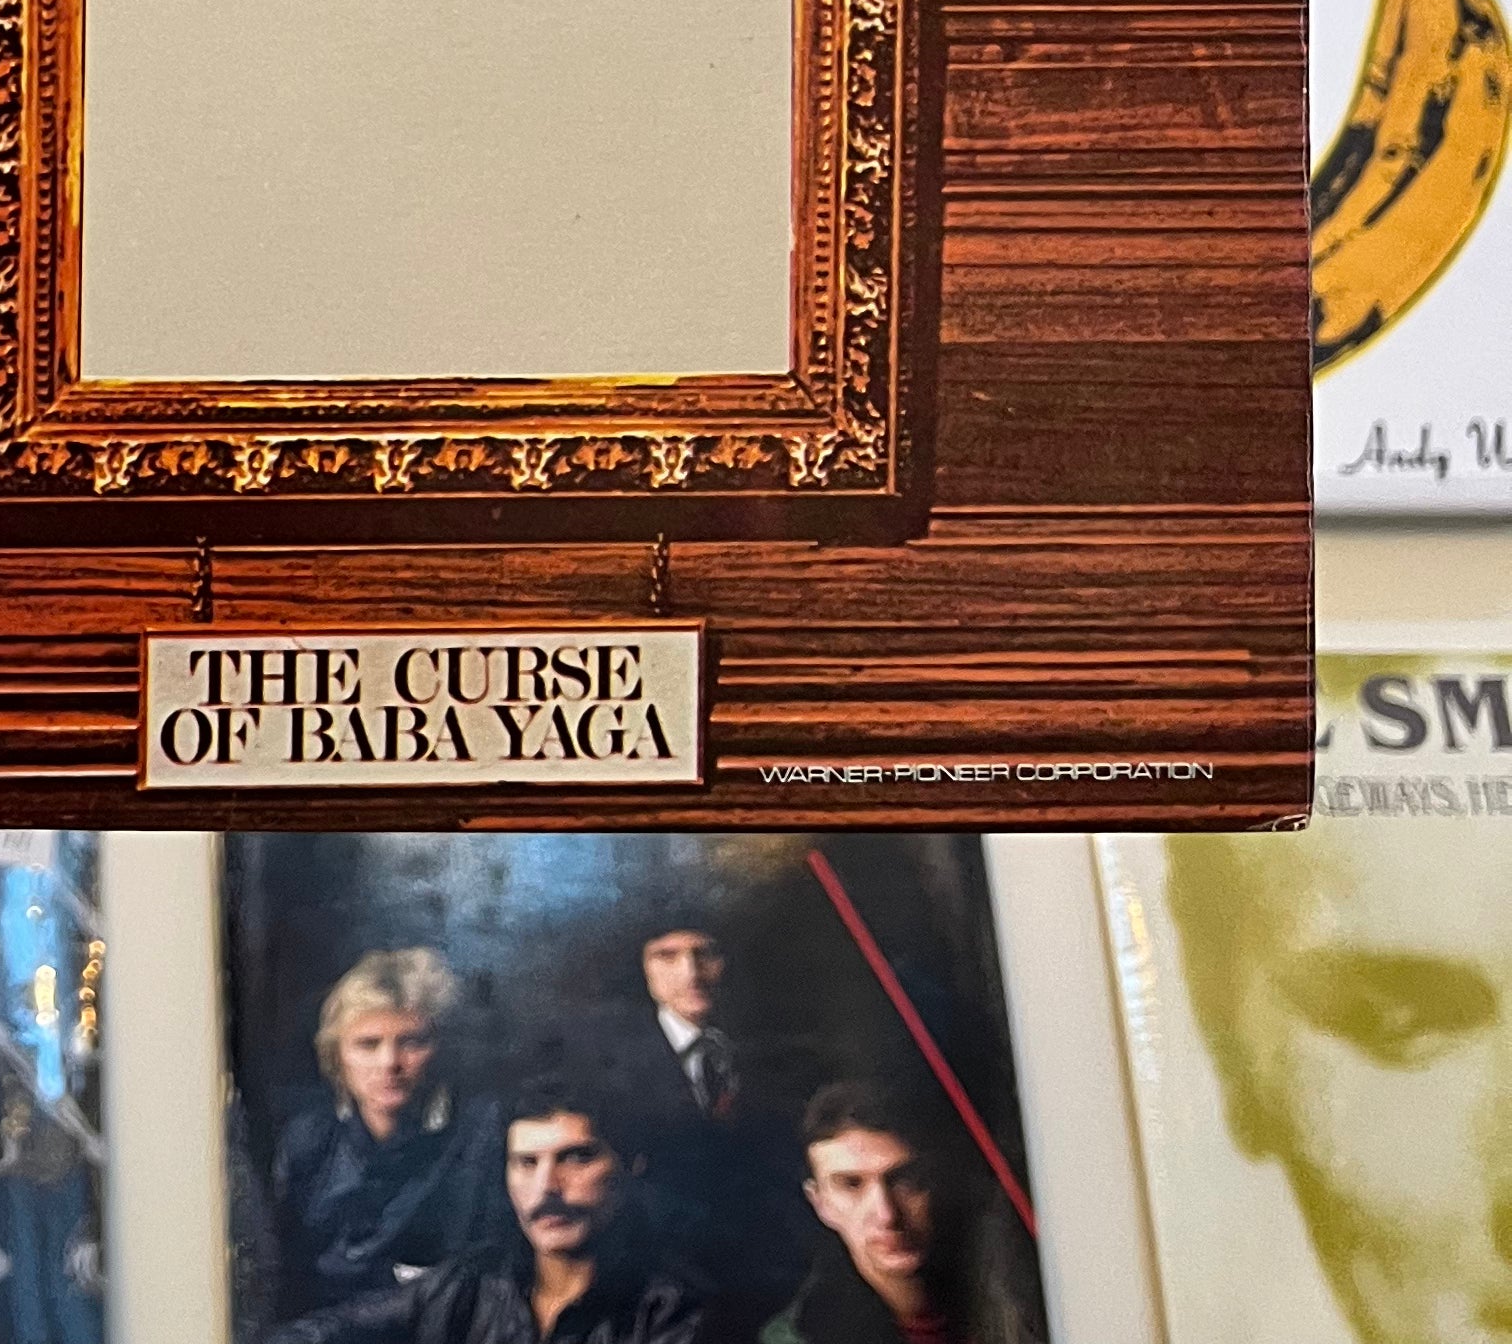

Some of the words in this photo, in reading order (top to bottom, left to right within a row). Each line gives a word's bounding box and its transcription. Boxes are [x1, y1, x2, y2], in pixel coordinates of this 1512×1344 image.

[1338, 419, 1451, 482] Andy
[189, 648, 362, 707] THE
[394, 645, 644, 705] CURSE
[159, 707, 262, 766] OF
[285, 704, 475, 763] BABA
[488, 703, 678, 762] YAGA
[758, 763, 1010, 783] WARNER-PIONEER
[1015, 761, 1214, 781] CORPORATION
